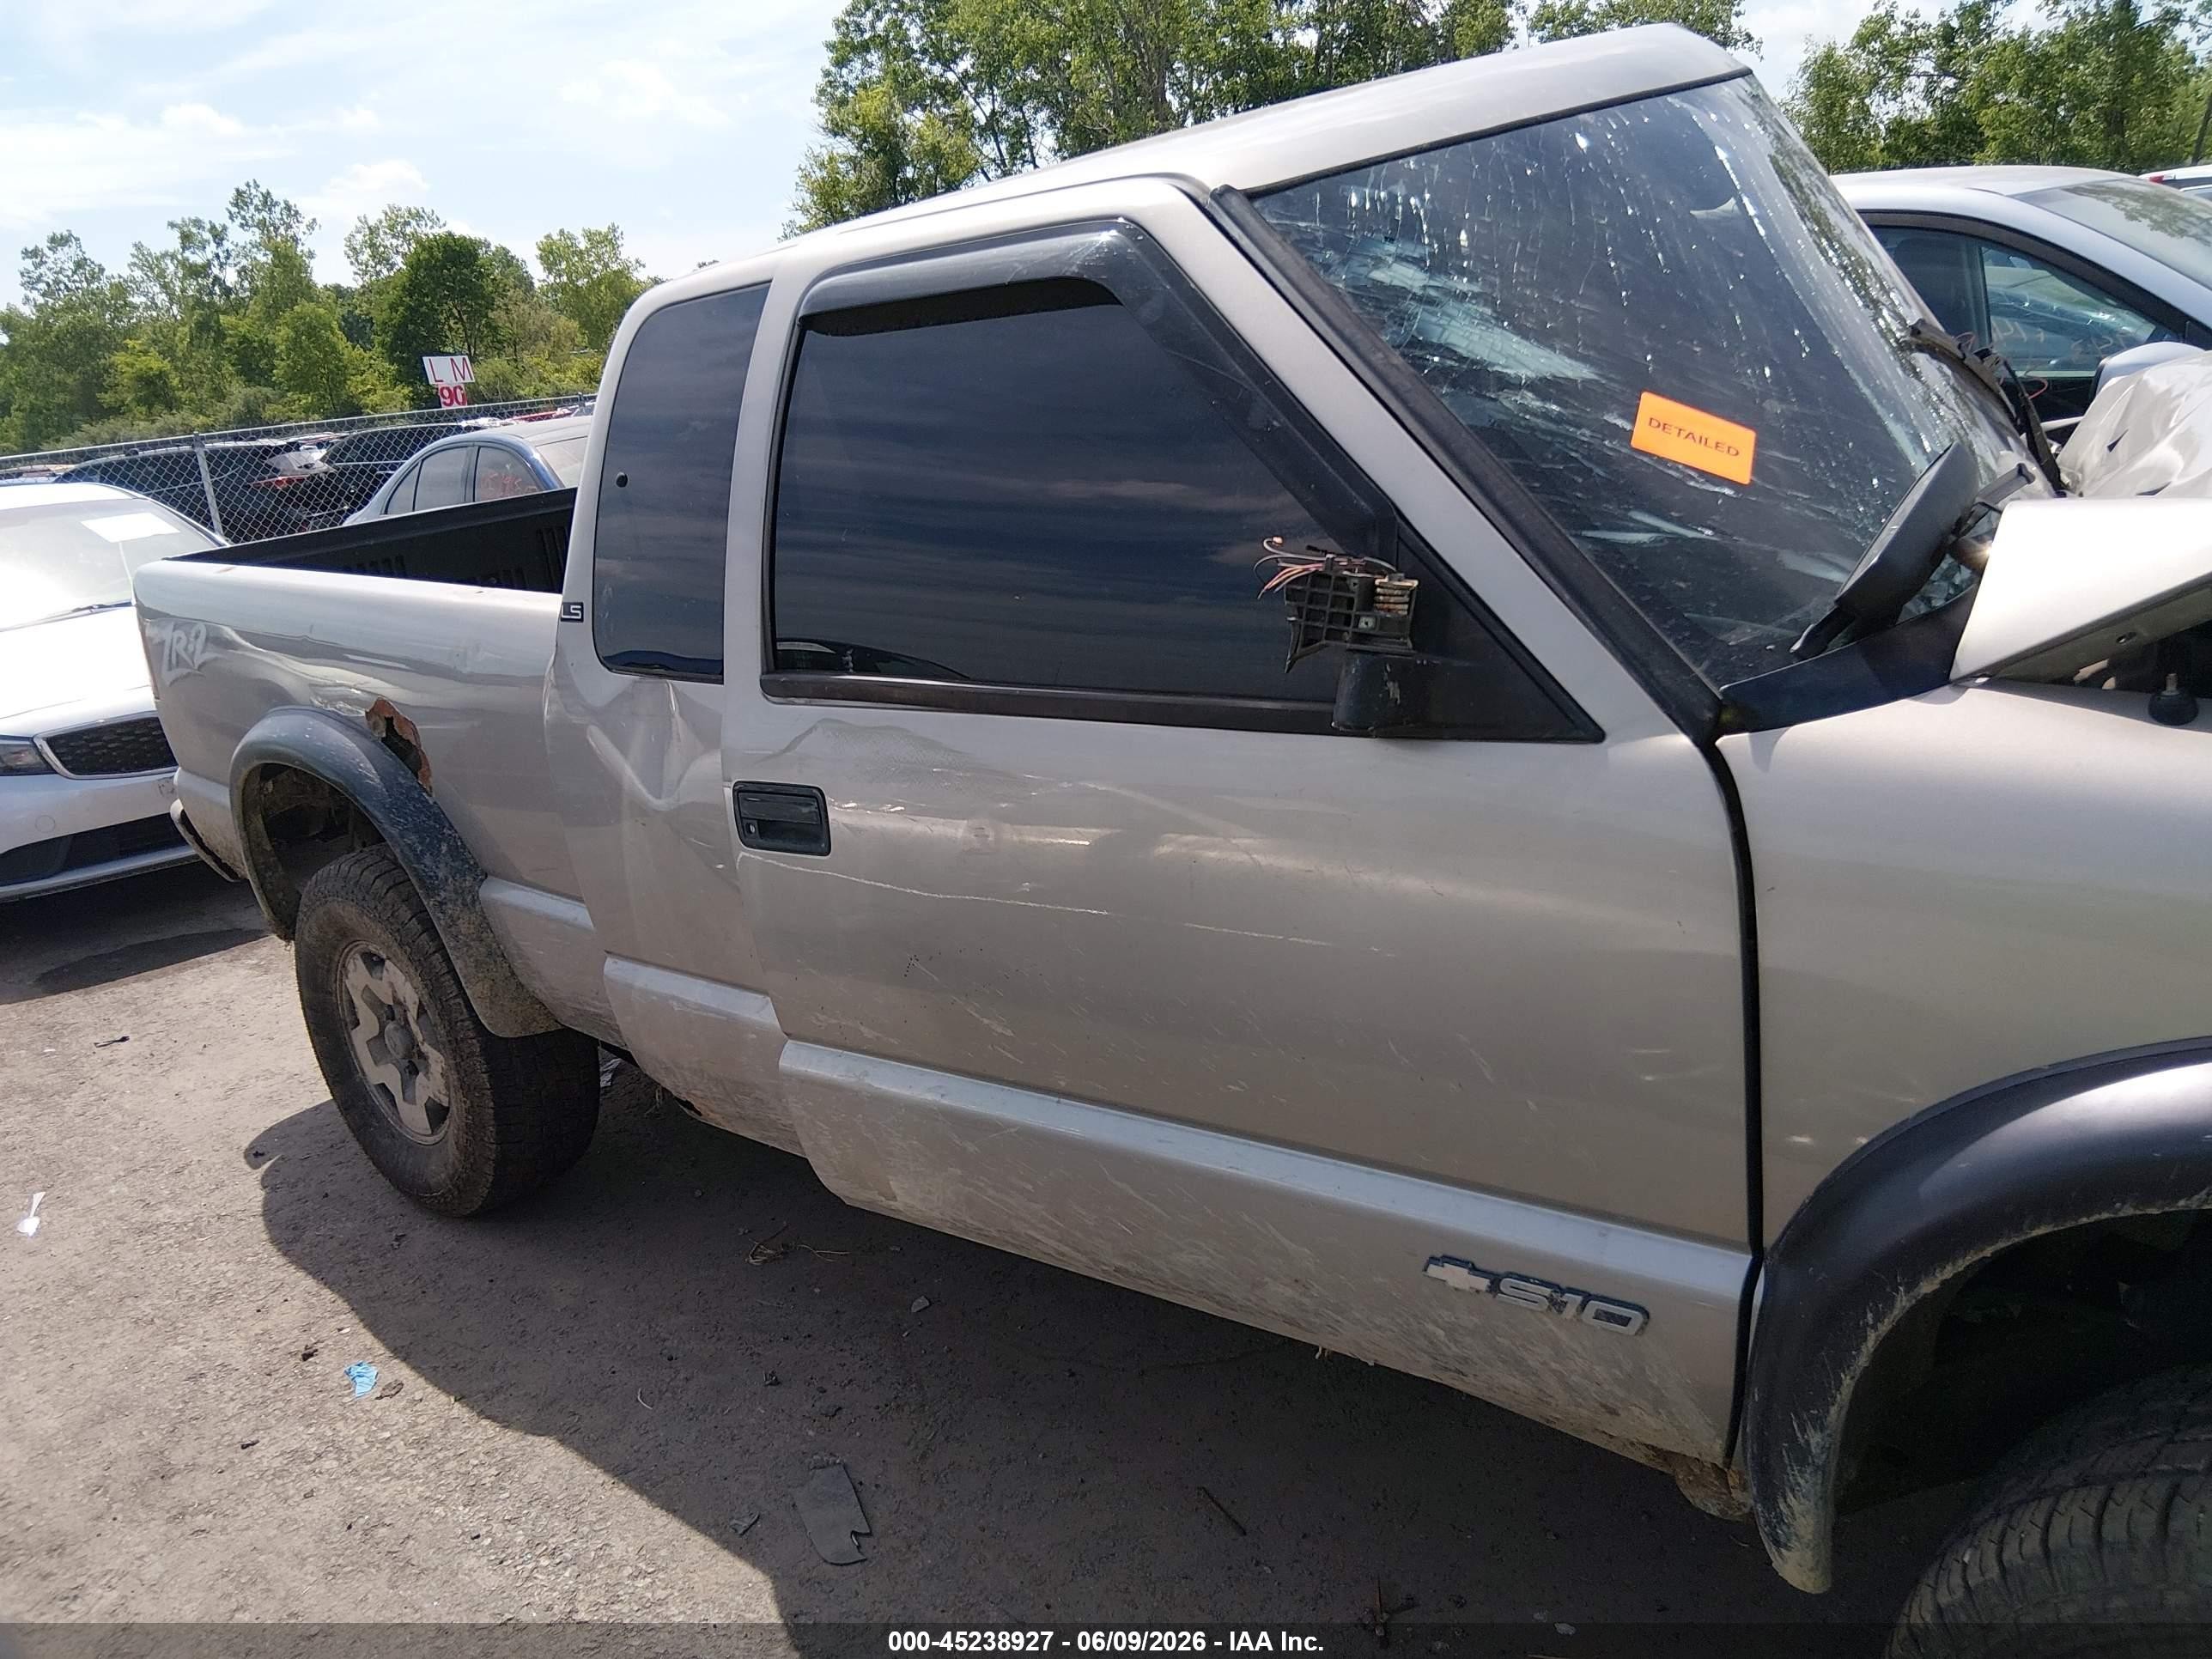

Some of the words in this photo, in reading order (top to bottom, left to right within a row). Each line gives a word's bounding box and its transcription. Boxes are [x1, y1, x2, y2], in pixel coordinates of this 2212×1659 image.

[428, 357, 444, 383] L
[450, 356, 473, 382] M
[439, 385, 468, 407] 90
[1648, 416, 1741, 458] DETAILED
[561, 604, 582, 619] LS
